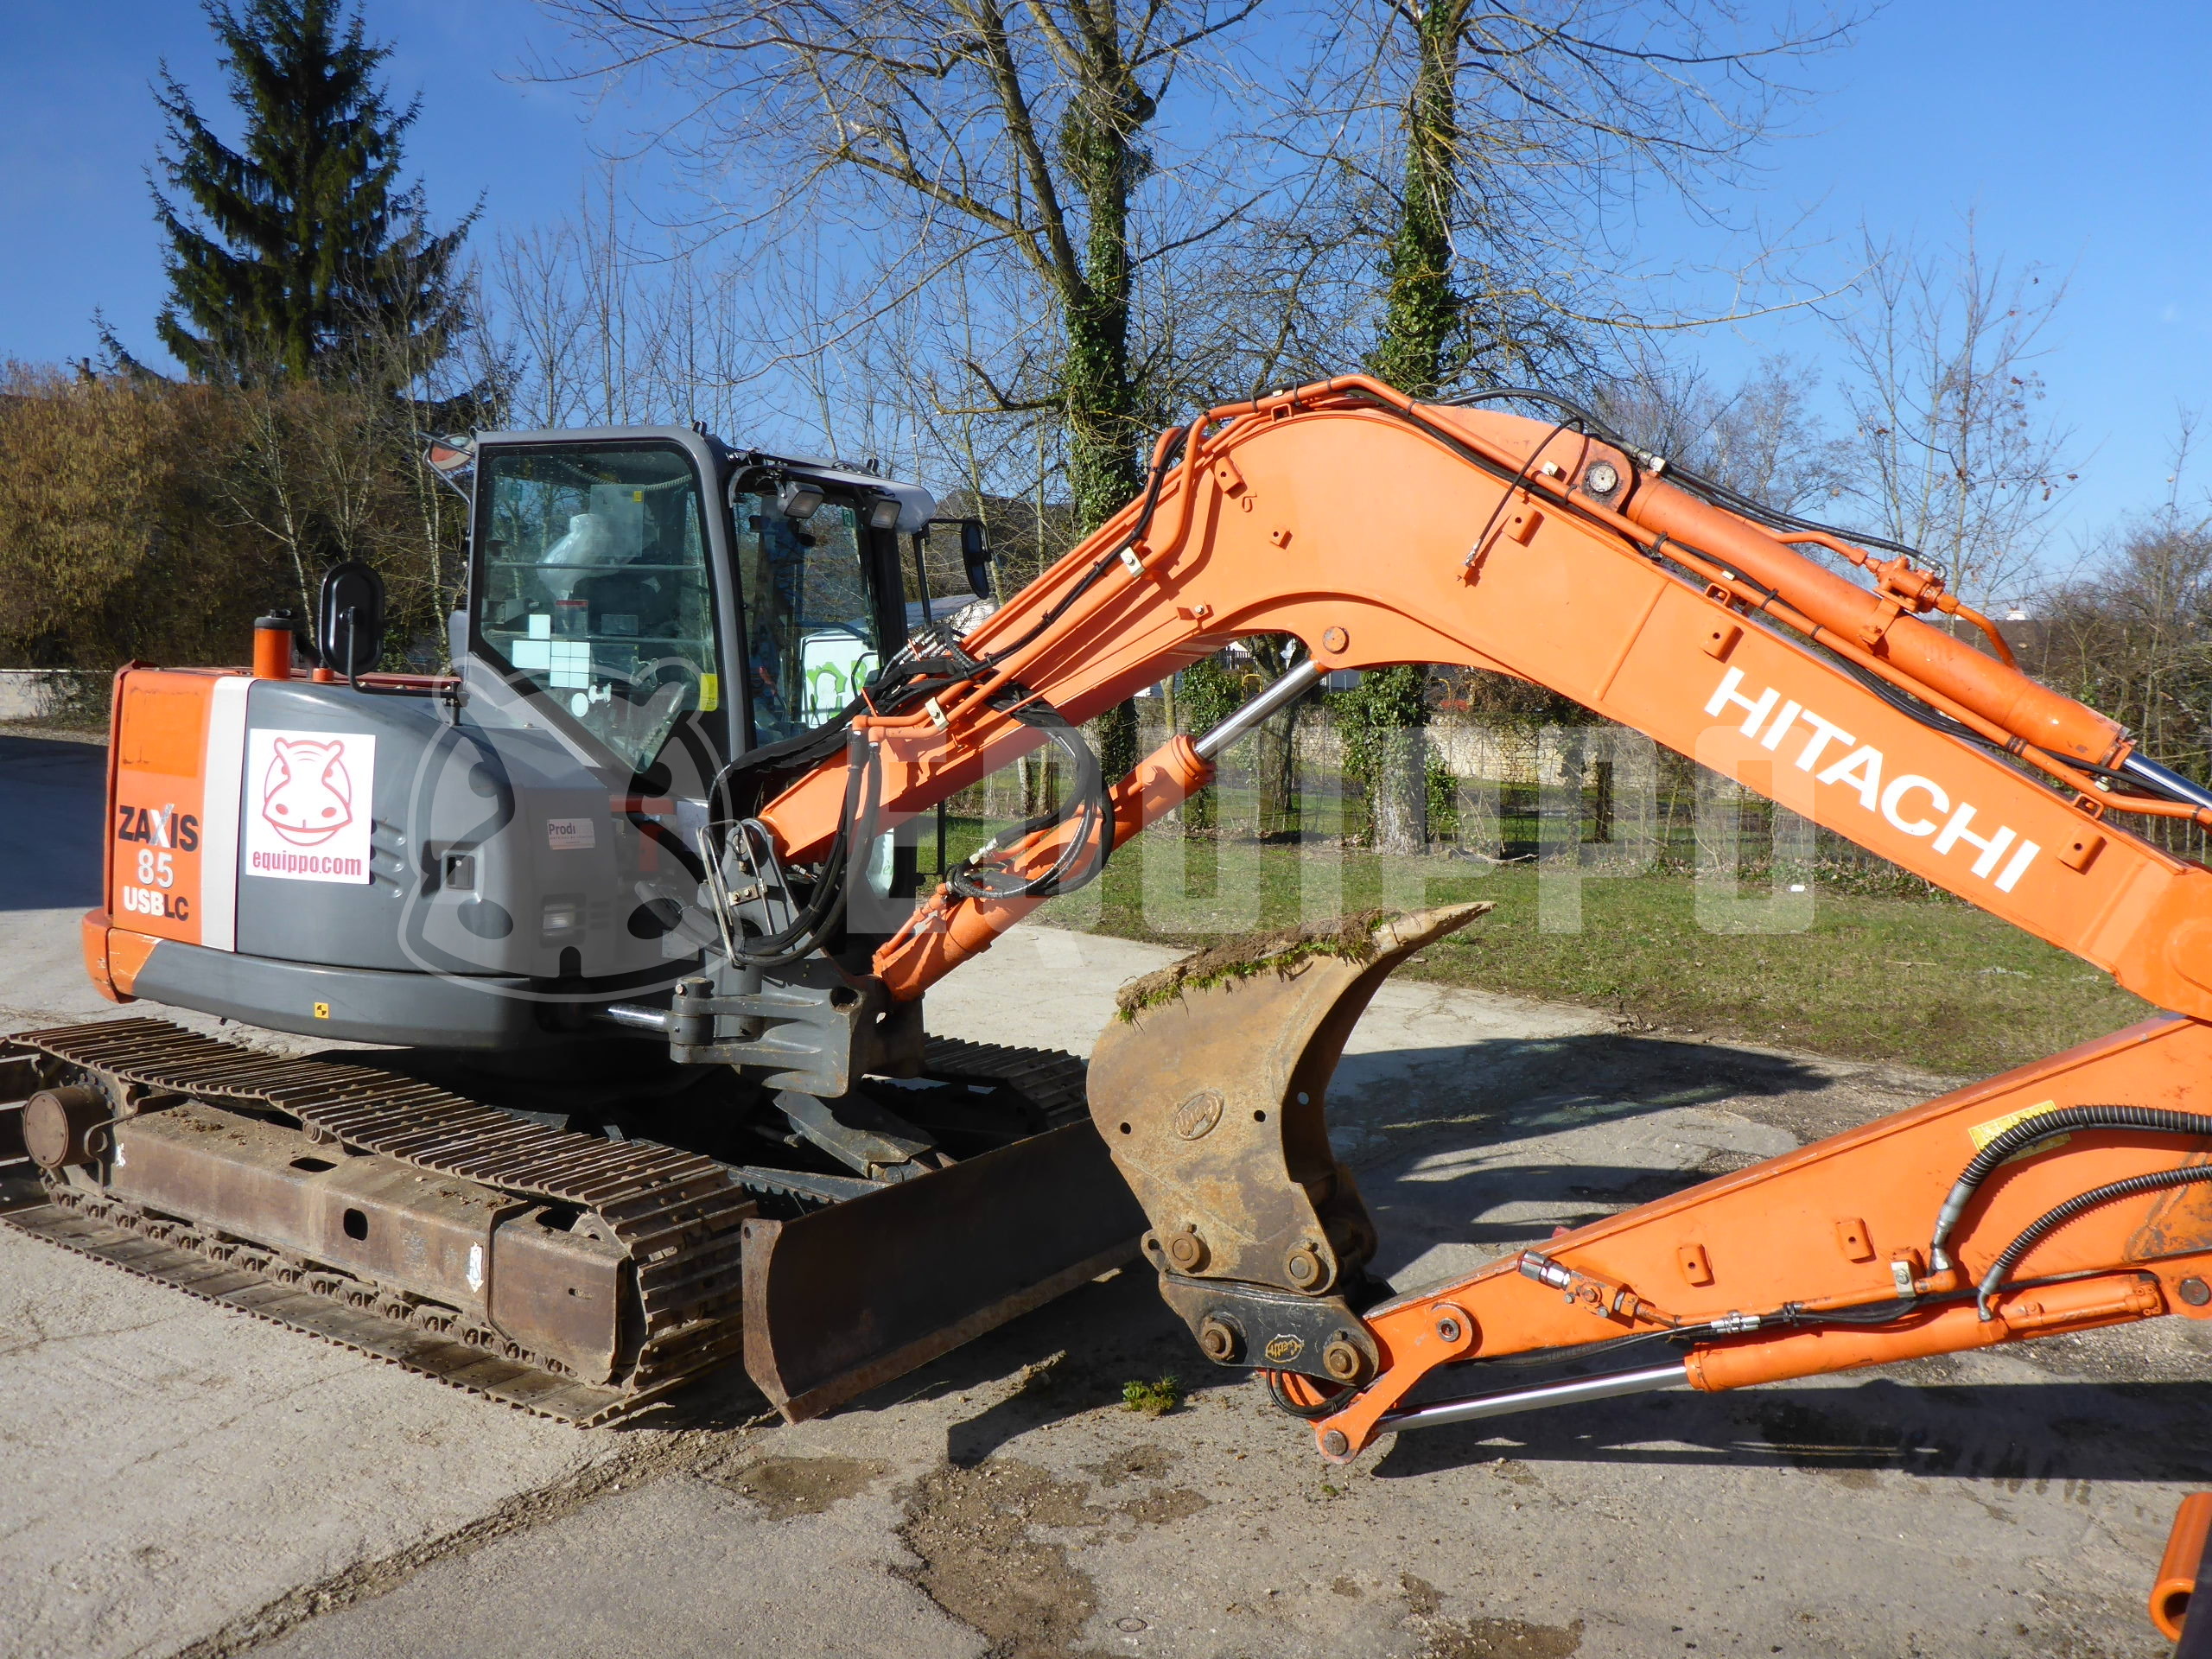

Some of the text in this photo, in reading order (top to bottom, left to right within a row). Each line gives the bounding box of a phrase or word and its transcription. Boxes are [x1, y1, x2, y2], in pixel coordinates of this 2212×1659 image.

[1704, 666, 2041, 893] HITACHI
[118, 804, 199, 852] ZAXIS
[138, 849, 174, 888] 85
[253, 850, 361, 875] equippo.com
